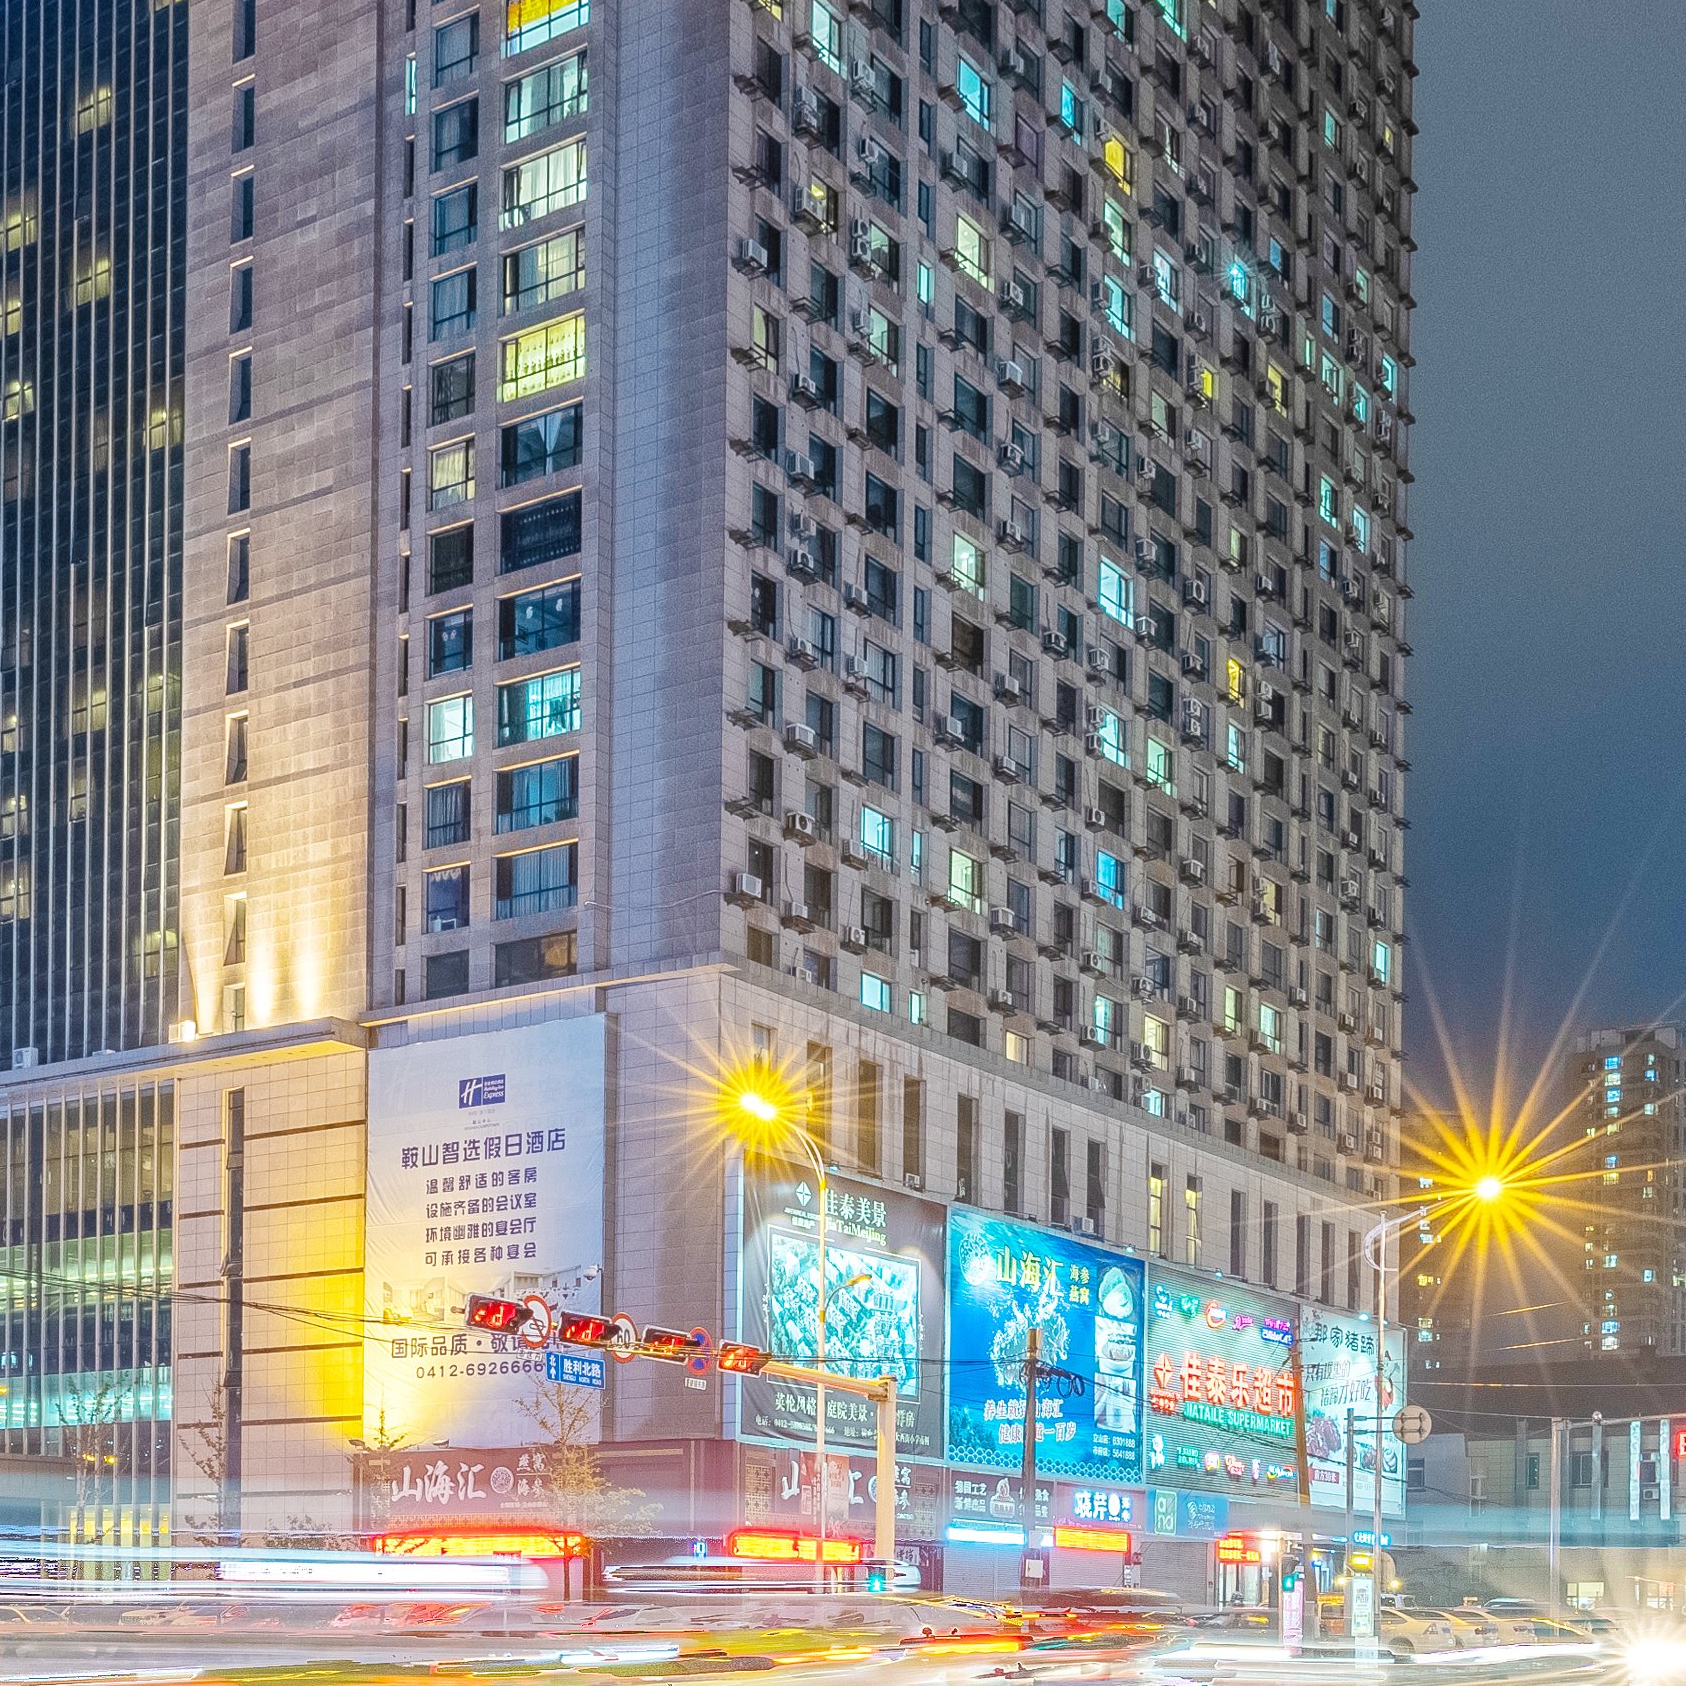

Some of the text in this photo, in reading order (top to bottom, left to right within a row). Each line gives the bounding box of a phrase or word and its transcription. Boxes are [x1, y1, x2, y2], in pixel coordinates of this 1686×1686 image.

[401, 1128, 566, 1169] 鞍山智选假日酒店
[426, 1167, 537, 1194] 温馨舒适的客房
[426, 1192, 537, 1219] 设施齐备的会议室
[825, 1188, 887, 1227] 佳泰美景
[425, 1217, 537, 1243] 环境幽雅的宴会厅
[425, 1242, 537, 1267] 可承接各种宴会
[996, 1245, 1064, 1298] 山海汇
[1069, 1264, 1090, 1284] 海参
[1069, 1285, 1090, 1306] 燕窝
[416, 1360, 544, 1379] 0412-6926666
[549, 1355, 556, 1367] 北
[564, 1359, 601, 1378] 胜利北路
[1180, 1350, 1295, 1416] 佳泰乐超市
[1227, 1412, 1291, 1436] SUPERMARKET
[391, 1460, 486, 1505] 山海汇
[517, 1478, 544, 1498] 海参
